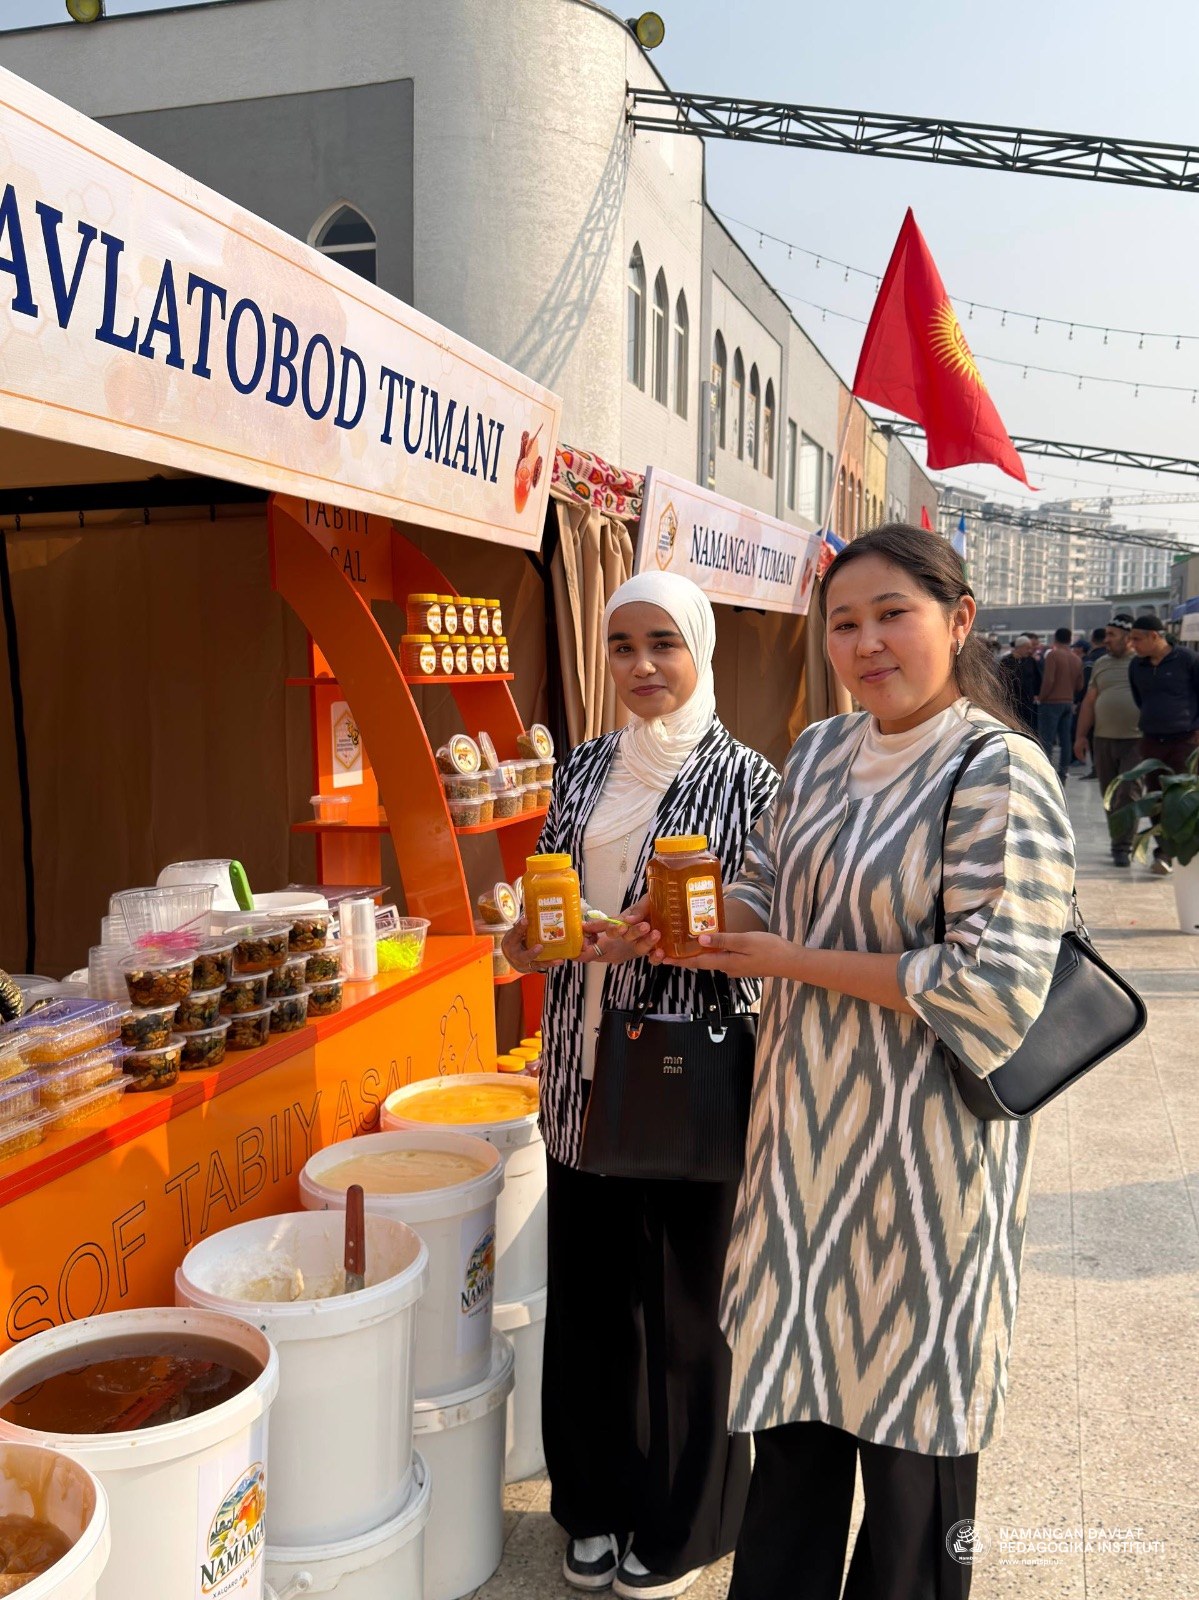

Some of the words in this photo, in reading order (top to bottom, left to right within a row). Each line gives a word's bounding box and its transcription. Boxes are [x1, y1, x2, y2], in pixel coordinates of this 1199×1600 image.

[379, 365, 505, 483] TUMANI
[689, 524, 758, 576] NAMANGAN
[758, 543, 796, 585] TUMANI
[6, 1200, 146, 1342] SOF
[165, 1090, 322, 1246] TABIIY
